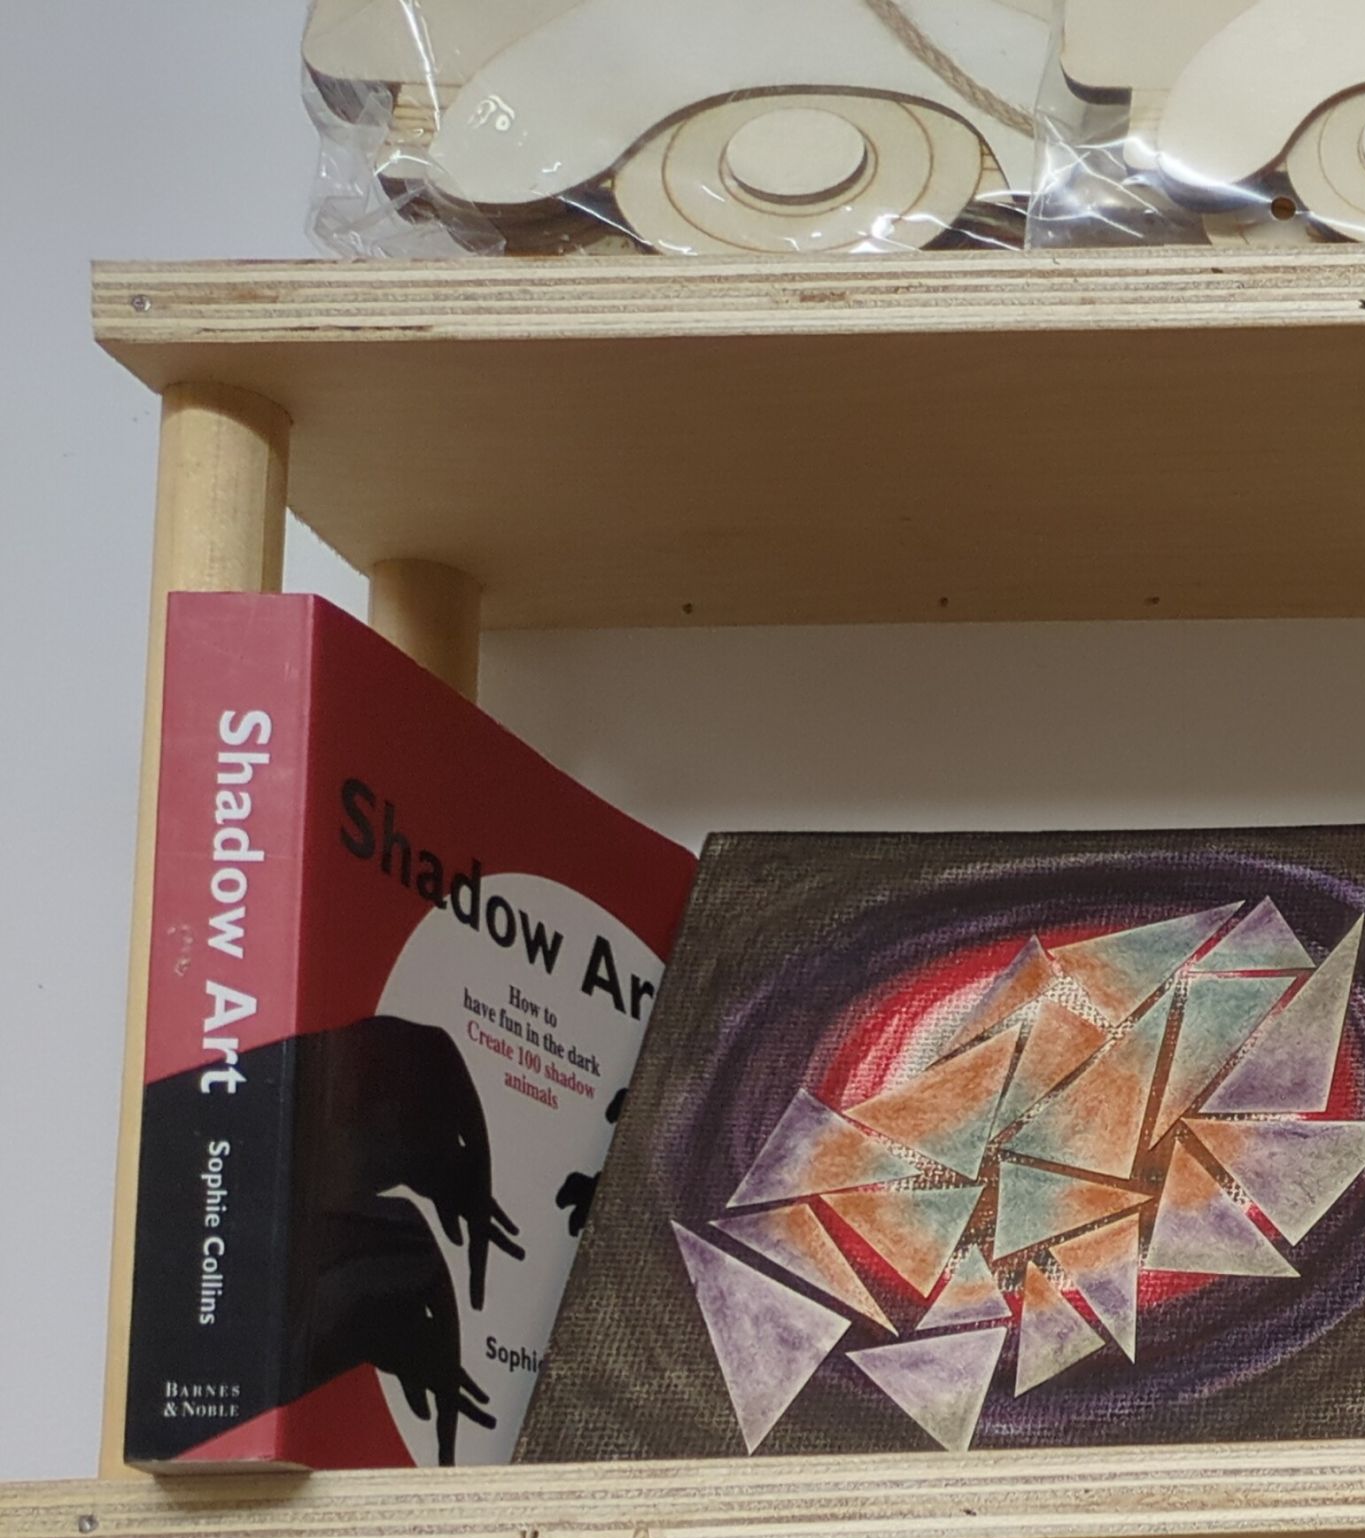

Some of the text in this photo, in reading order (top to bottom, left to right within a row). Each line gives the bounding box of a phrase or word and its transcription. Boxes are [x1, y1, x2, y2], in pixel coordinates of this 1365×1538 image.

[199, 710, 272, 1094] Shadow Art
[339, 777, 655, 1021] Shadow Ar
[463, 986, 601, 1077] have fun in the dark
[508, 984, 558, 1028] How to
[466, 1019, 596, 1099] Create 100 shadow
[504, 1071, 559, 1110] animals
[199, 1140, 230, 1325] Sophie Collins
[165, 1381, 241, 1398] BARNES
